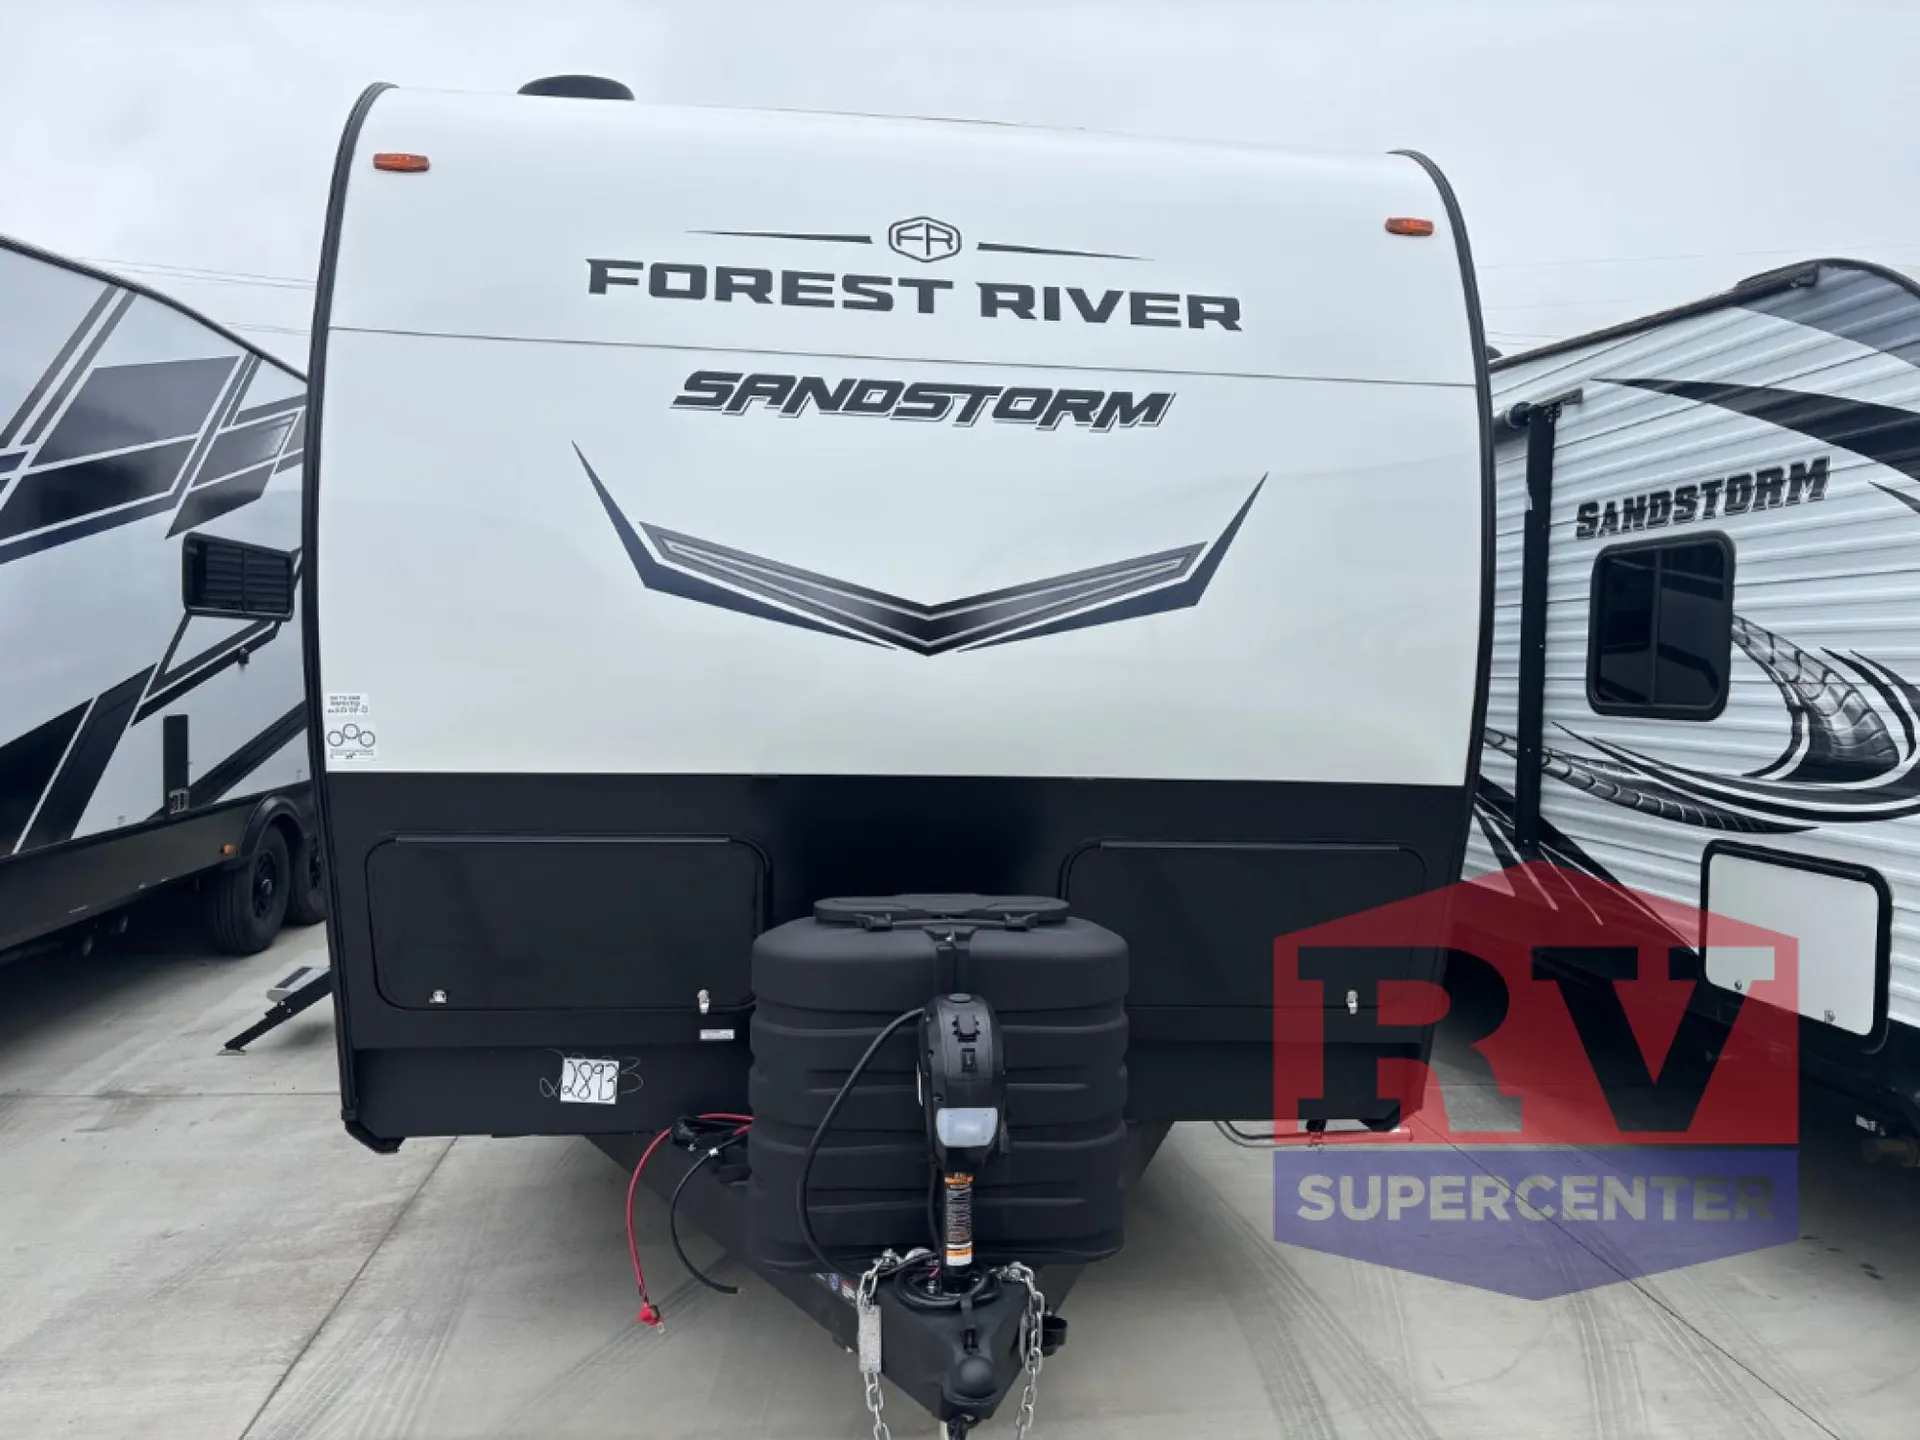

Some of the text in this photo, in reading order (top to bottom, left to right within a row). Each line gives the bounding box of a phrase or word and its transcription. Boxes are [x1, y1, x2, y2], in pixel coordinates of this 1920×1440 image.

[586, 258, 1243, 331] FOREST RIVER
[669, 369, 1177, 433] SANDSTORM
[1575, 456, 1831, 540] SANDSTORM
